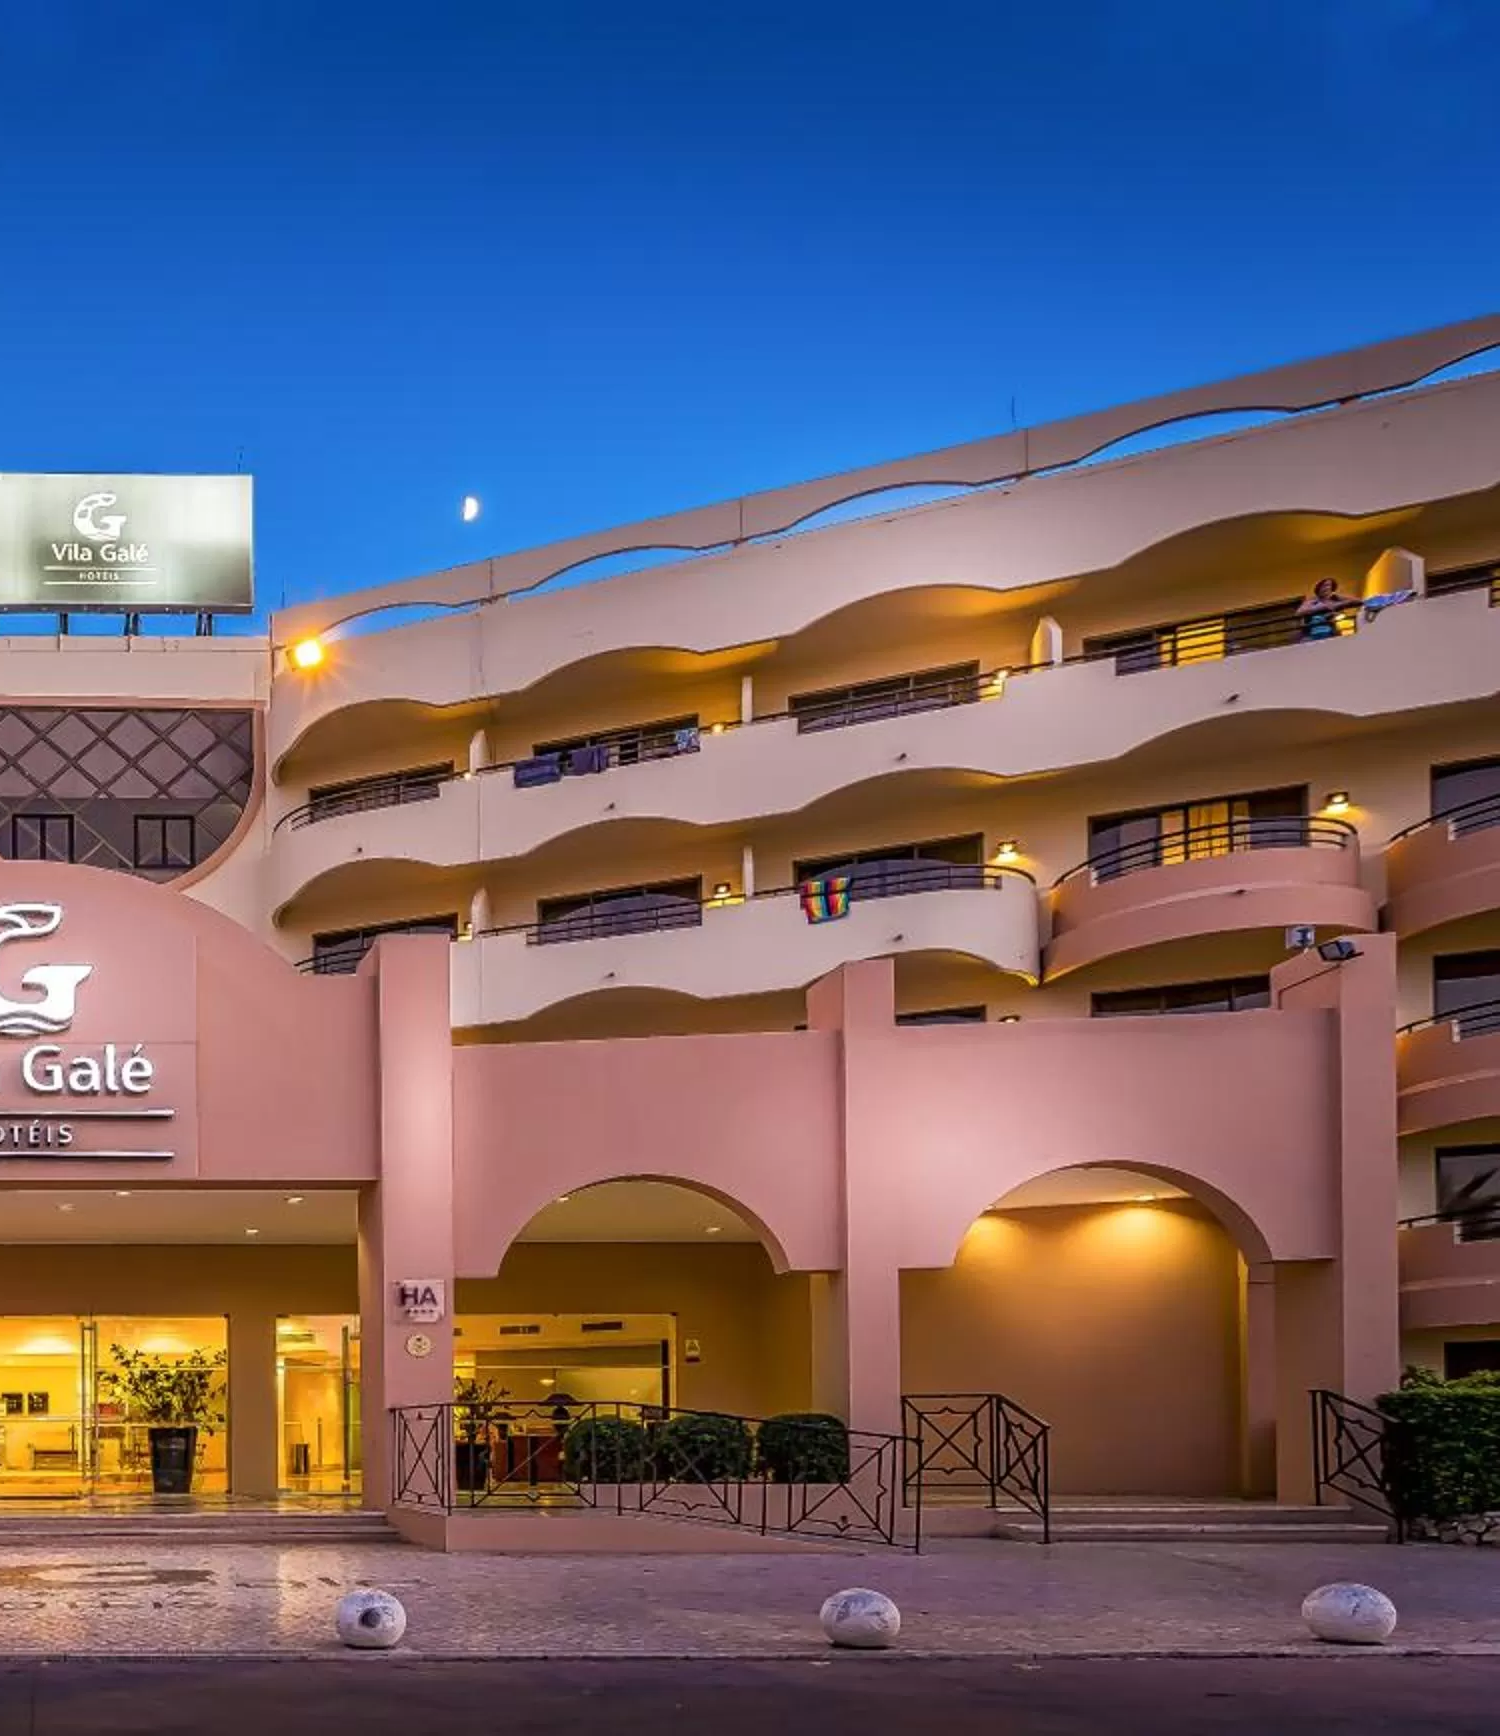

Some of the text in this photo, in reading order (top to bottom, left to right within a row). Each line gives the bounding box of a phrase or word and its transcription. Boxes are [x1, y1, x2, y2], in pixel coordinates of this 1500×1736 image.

[51, 543, 149, 562] Vila Galé
[21, 1043, 155, 1094] Galé
[399, 1286, 438, 1306] HA
